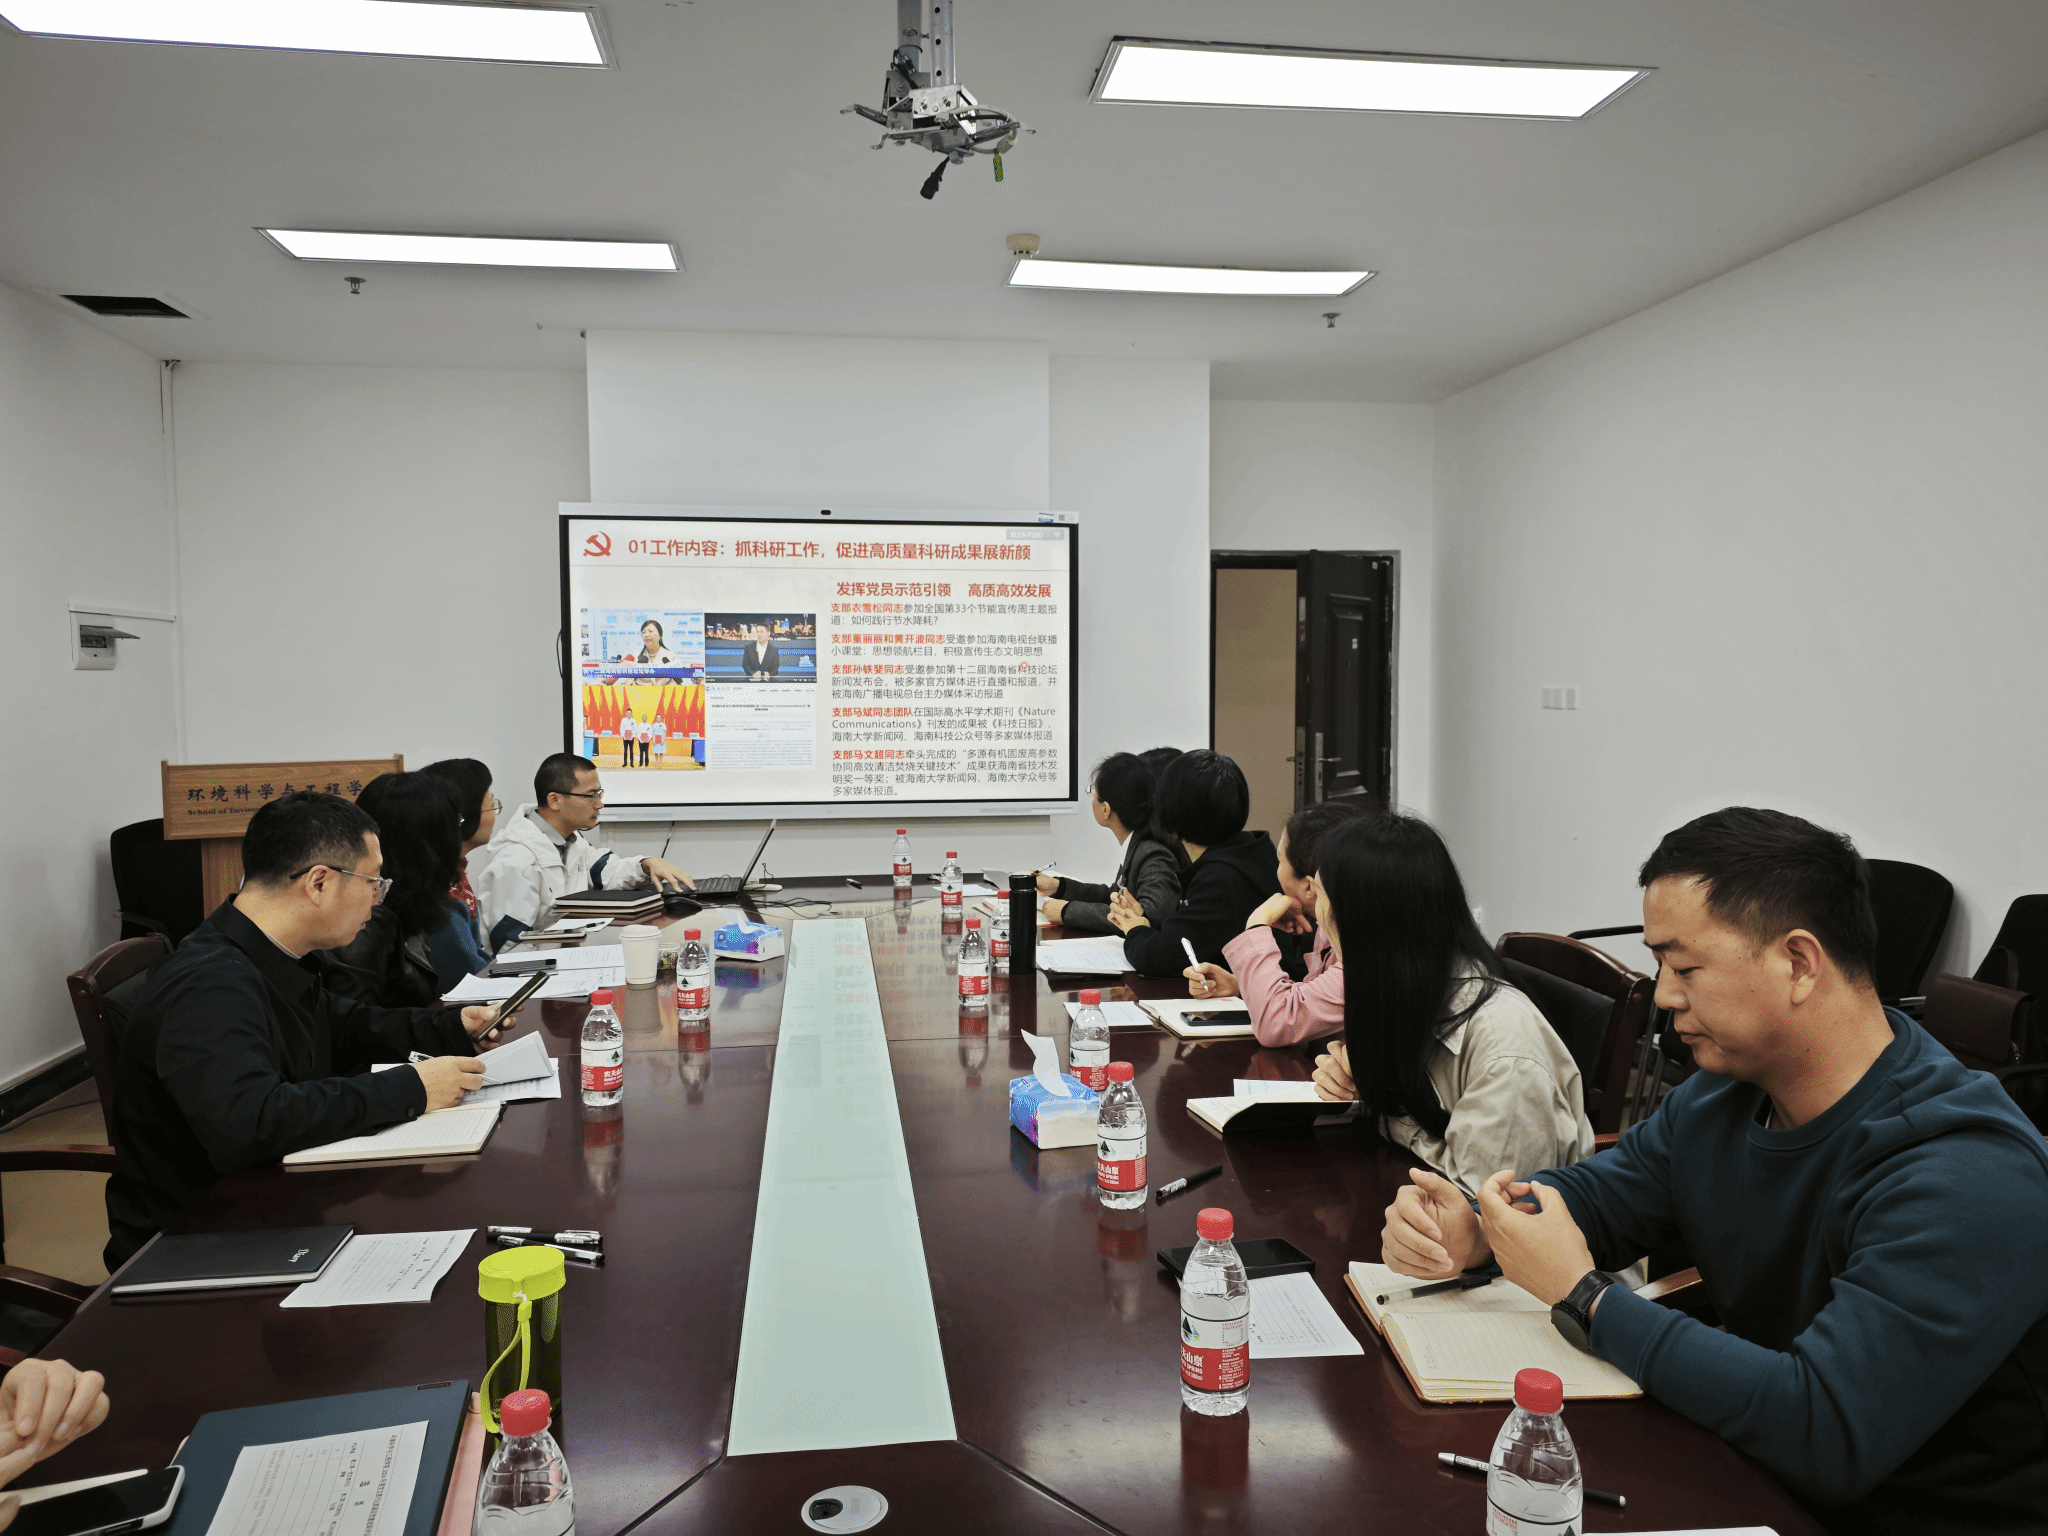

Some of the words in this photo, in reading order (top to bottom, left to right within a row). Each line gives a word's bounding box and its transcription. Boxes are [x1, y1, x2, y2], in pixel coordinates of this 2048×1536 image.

[628, 539, 1031, 561] 01工作内容：抓科研工作，促进高质量科研成果展新颜
[836, 581, 952, 597] 发挥党员示范引领
[968, 583, 1052, 598] 高质高效发展
[832, 688, 1004, 699] 被海南广播电视总台主办媒体采访报道
